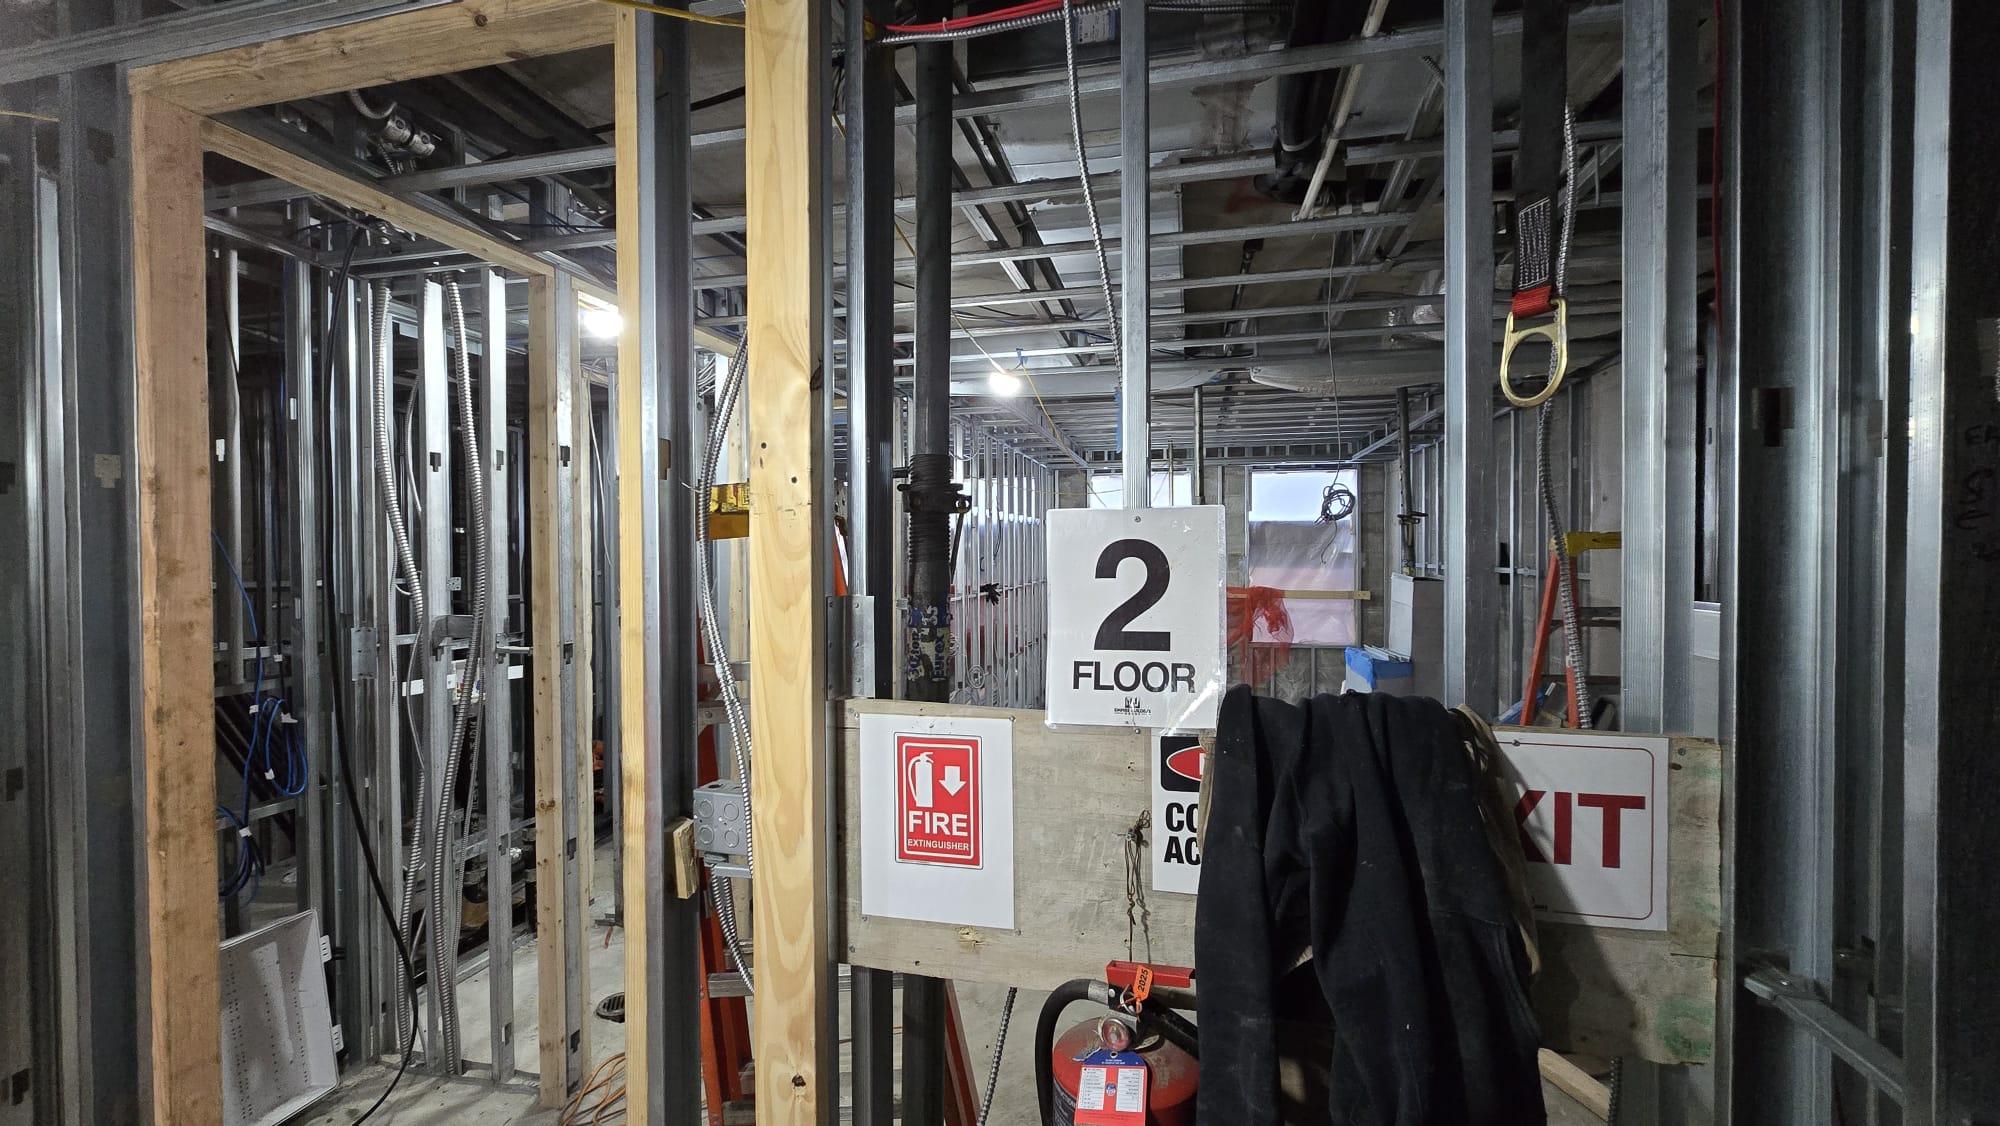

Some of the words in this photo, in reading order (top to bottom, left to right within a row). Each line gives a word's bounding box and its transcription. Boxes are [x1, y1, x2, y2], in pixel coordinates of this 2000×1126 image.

[1094, 539, 1170, 651] 2
[1072, 660, 1196, 693] FLOOR
[908, 810, 969, 837] FIRE
[1514, 790, 1646, 869] XIT
[907, 838, 970, 852] EXTINGUISHER
[1137, 967, 1149, 993] 2025
